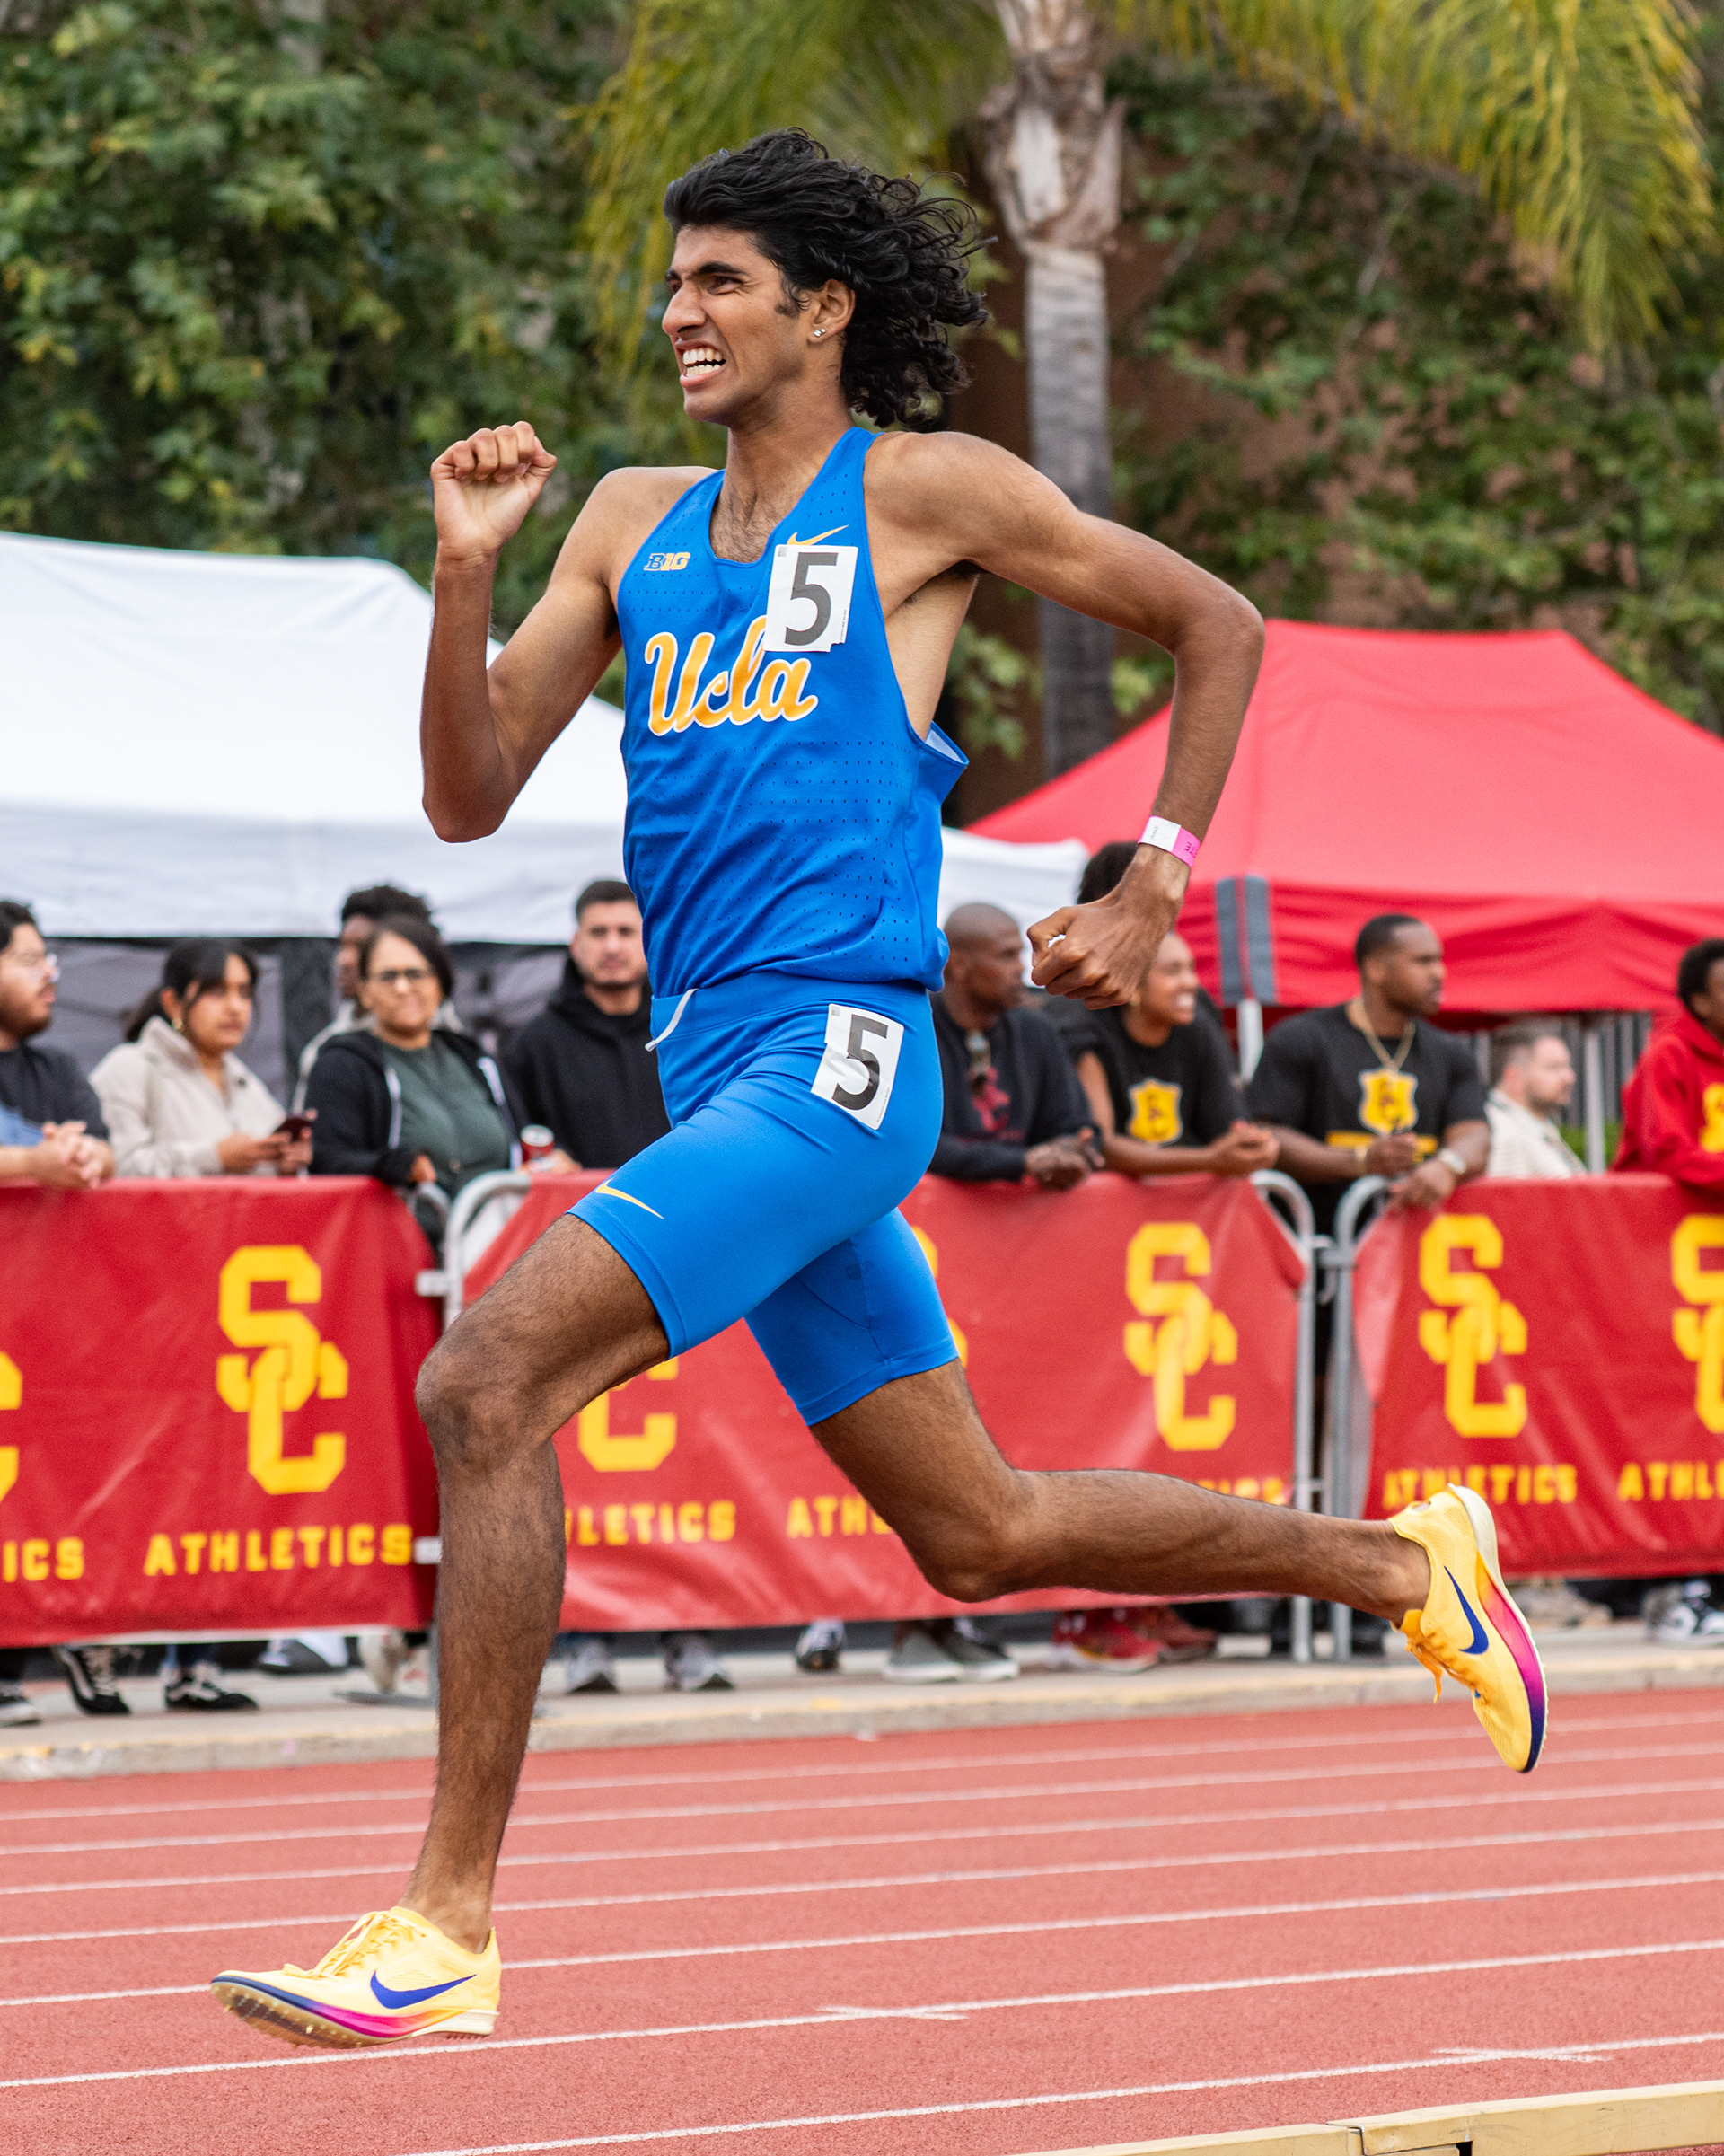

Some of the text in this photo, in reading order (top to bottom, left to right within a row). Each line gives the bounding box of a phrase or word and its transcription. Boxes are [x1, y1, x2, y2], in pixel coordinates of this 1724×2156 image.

[784, 551, 839, 646] 5
[831, 1013, 889, 1111] 5
[144, 1524, 412, 1576] ATHLETICS
[565, 1500, 736, 1547] LETICS
